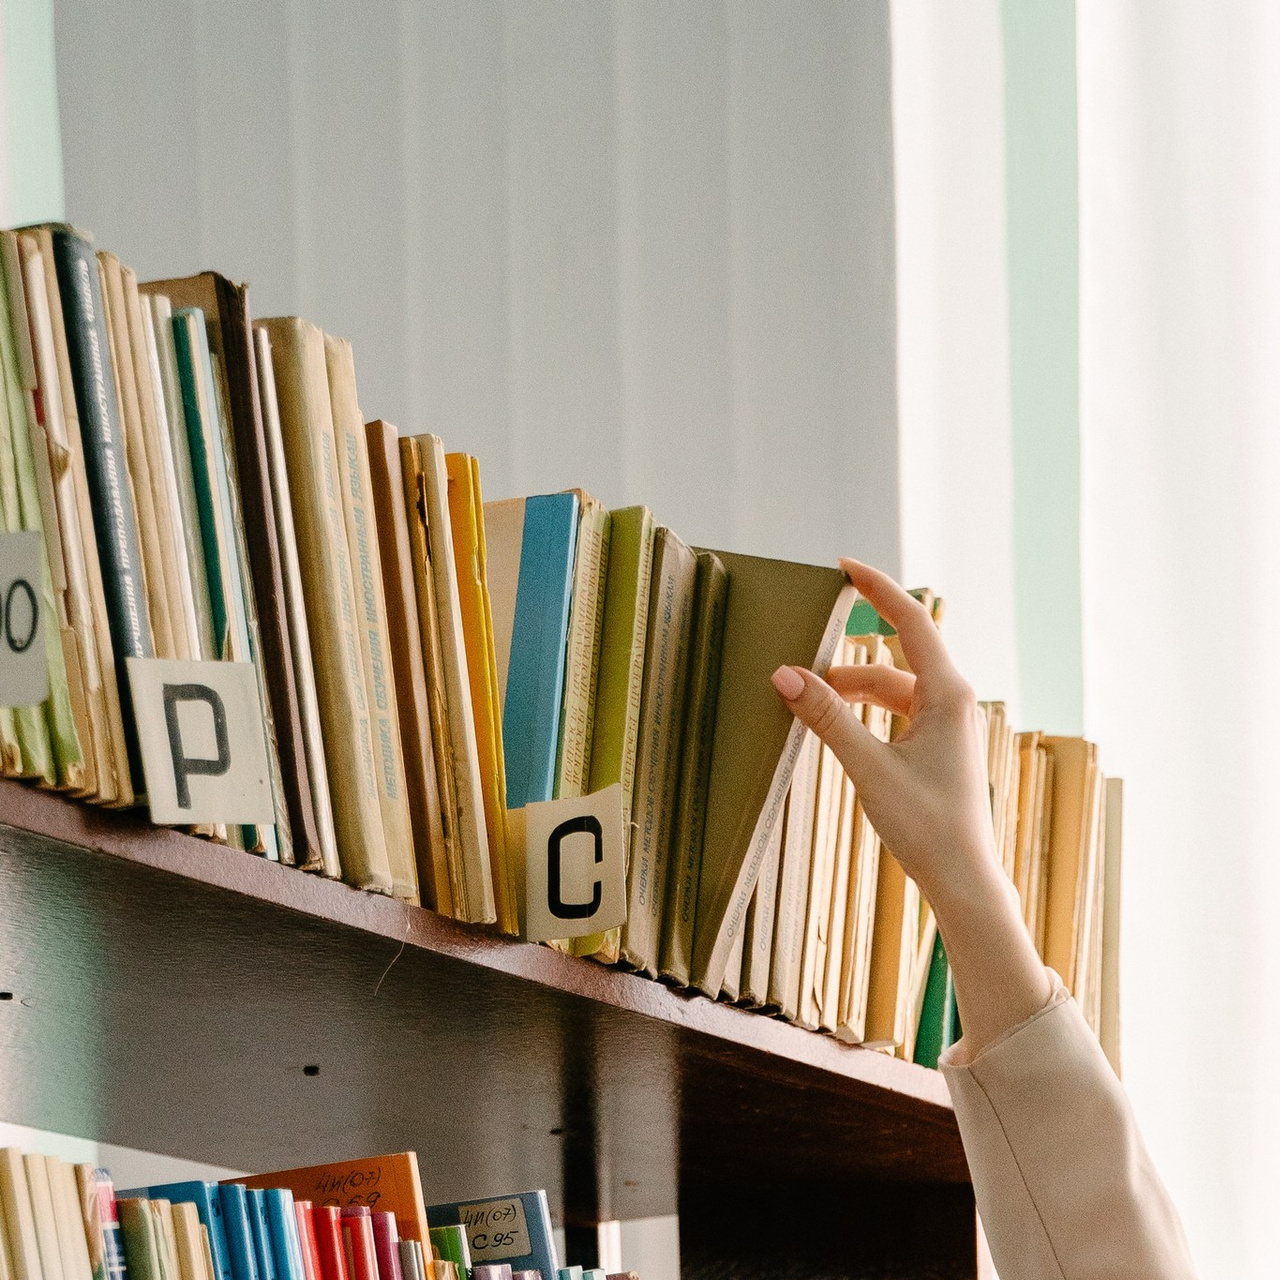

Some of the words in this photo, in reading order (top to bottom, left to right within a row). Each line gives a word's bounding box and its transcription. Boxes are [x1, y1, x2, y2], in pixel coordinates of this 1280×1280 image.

[78, 258, 96, 322] ЯЗЫКОВ
[88, 328, 112, 443] ИНОСТРАННЫХ
[345, 432, 362, 501] ЯЗЫКАМ
[105, 448, 131, 569] ПРЕПОДАВАНИЯ
[353, 506, 376, 623] ИНОСТРАННЫМ
[663, 575, 675, 624] ЯЗЫКАМ
[368, 629, 387, 710] ОБУЧЕНИЯ
[653, 628, 671, 724] ИНОСТРАННЫМ
[163, 684, 231, 808] Р
[378, 718, 397, 800] МЕТОДИКА
[563, 704, 581, 783] ВОПРОСЫ
[569, 704, 588, 785] ВОПРОСЫ
[621, 715, 638, 792] ВОПРОСЫ
[645, 728, 661, 792] ОБУЧЕНИЯ
[725, 891, 748, 938] ОЧЕРКИ
[743, 831, 768, 887] МЕТОДОВ
[763, 766, 792, 828] ОБУЧЕНИЯ
[820, 617, 843, 666] ЯЗЫКАМ
[640, 796, 655, 853] МЕТОДОВ
[548, 816, 603, 919] С
[636, 857, 649, 906] ОЧЕРКИ
[755, 905, 774, 950] ОЧЕРКИ
[472, 1234, 487, 1249] С
[491, 1231, 518, 1248] 95
